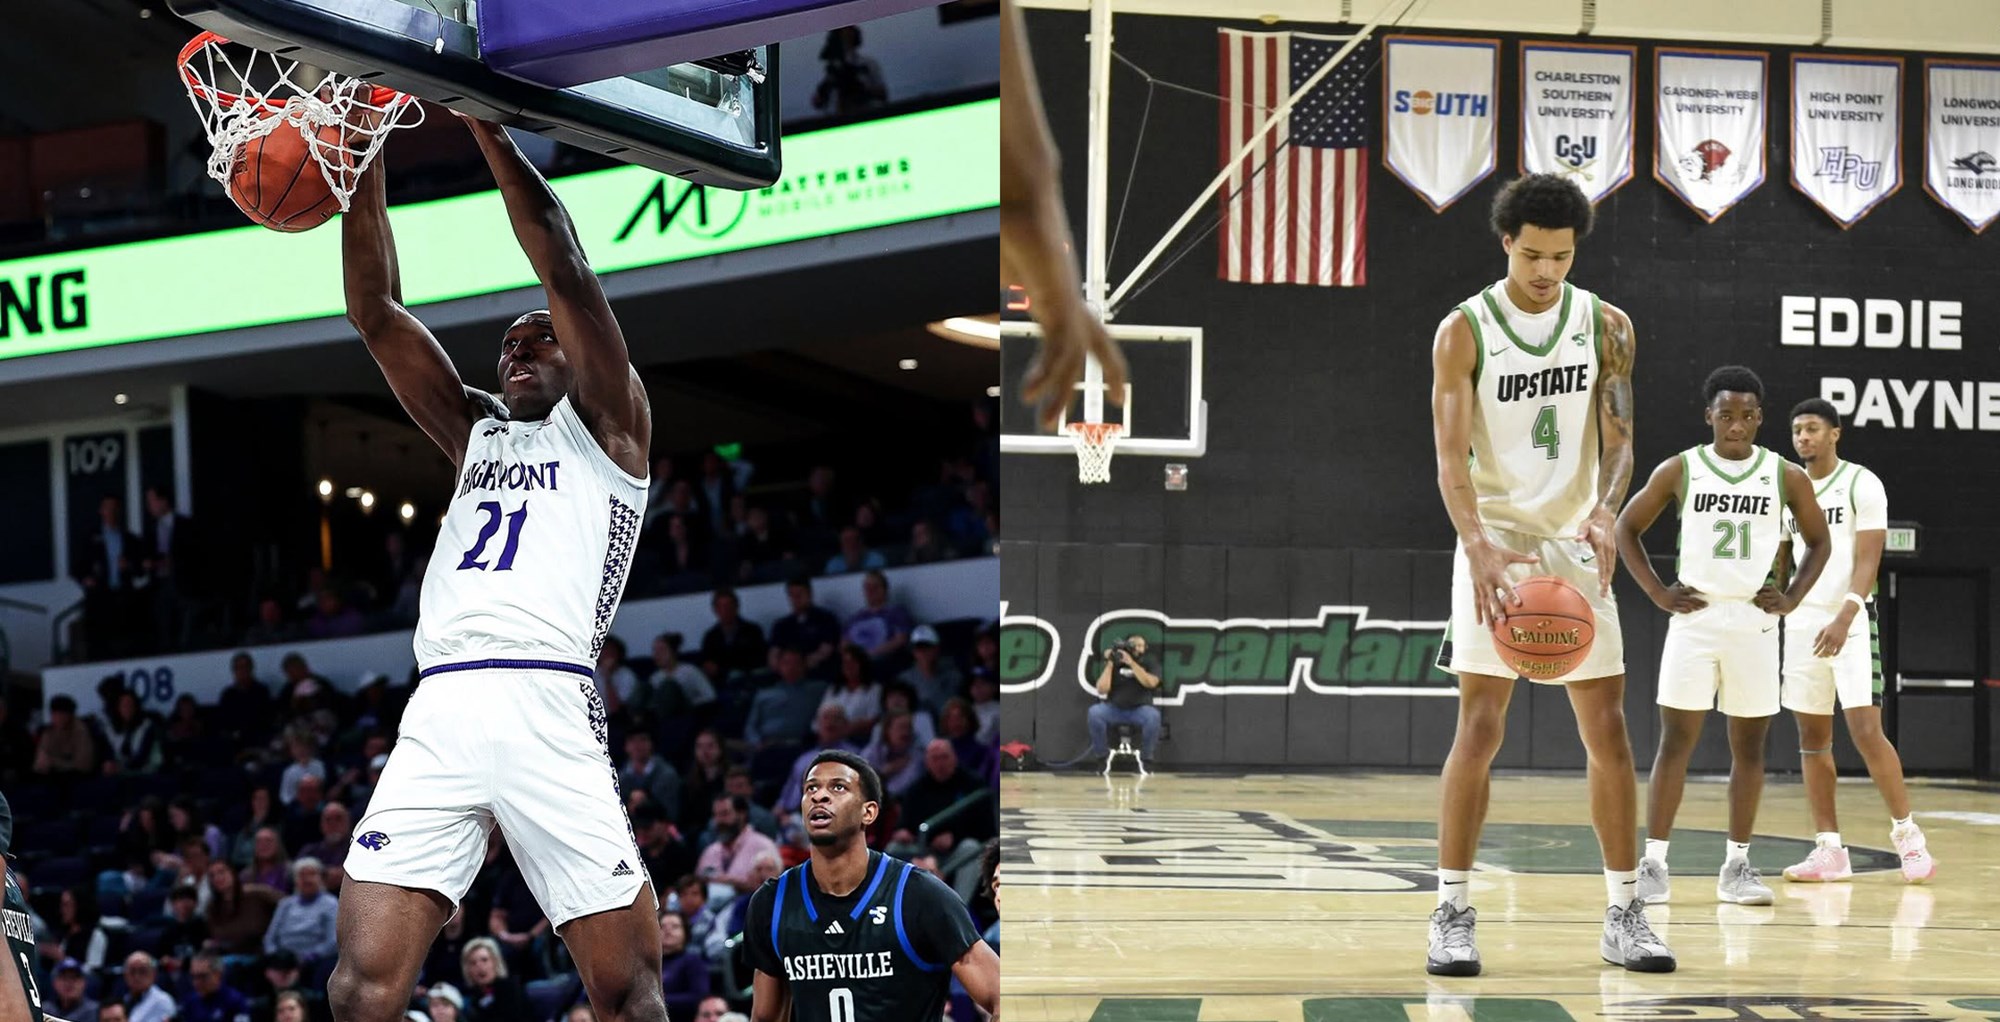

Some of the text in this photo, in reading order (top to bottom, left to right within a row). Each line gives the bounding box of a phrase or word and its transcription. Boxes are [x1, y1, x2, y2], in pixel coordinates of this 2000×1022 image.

[1535, 71, 1621, 86] CHARLESTON
[1662, 85, 1759, 101] GARDNER-WEBB
[1542, 88, 1612, 102] SOUTHERN
[1676, 103, 1745, 116] UNIVERSITY
[1809, 91, 1885, 107] HIGH POINT
[1537, 106, 1616, 121] UNIVERSITY
[1807, 109, 1885, 124] UNIVERSITY
[1555, 134, 1597, 167] CSU
[760, 159, 909, 197] MATTHEWS
[1813, 146, 1882, 192] HPU
[1946, 175, 2000, 190] LONGWOO
[1781, 295, 1963, 350] EDDIE
[1497, 363, 1588, 403] UPSTATE
[1820, 377, 2000, 431] PAYNE
[1531, 404, 1560, 460] 4
[67, 438, 121, 475] 109
[1693, 493, 1771, 516] UPSTATE
[456, 499, 528, 571] 21
[1712, 519, 1752, 560] 21
[1510, 626, 1579, 646] SPALDING
[783, 950, 894, 981] ASHEVILLE
